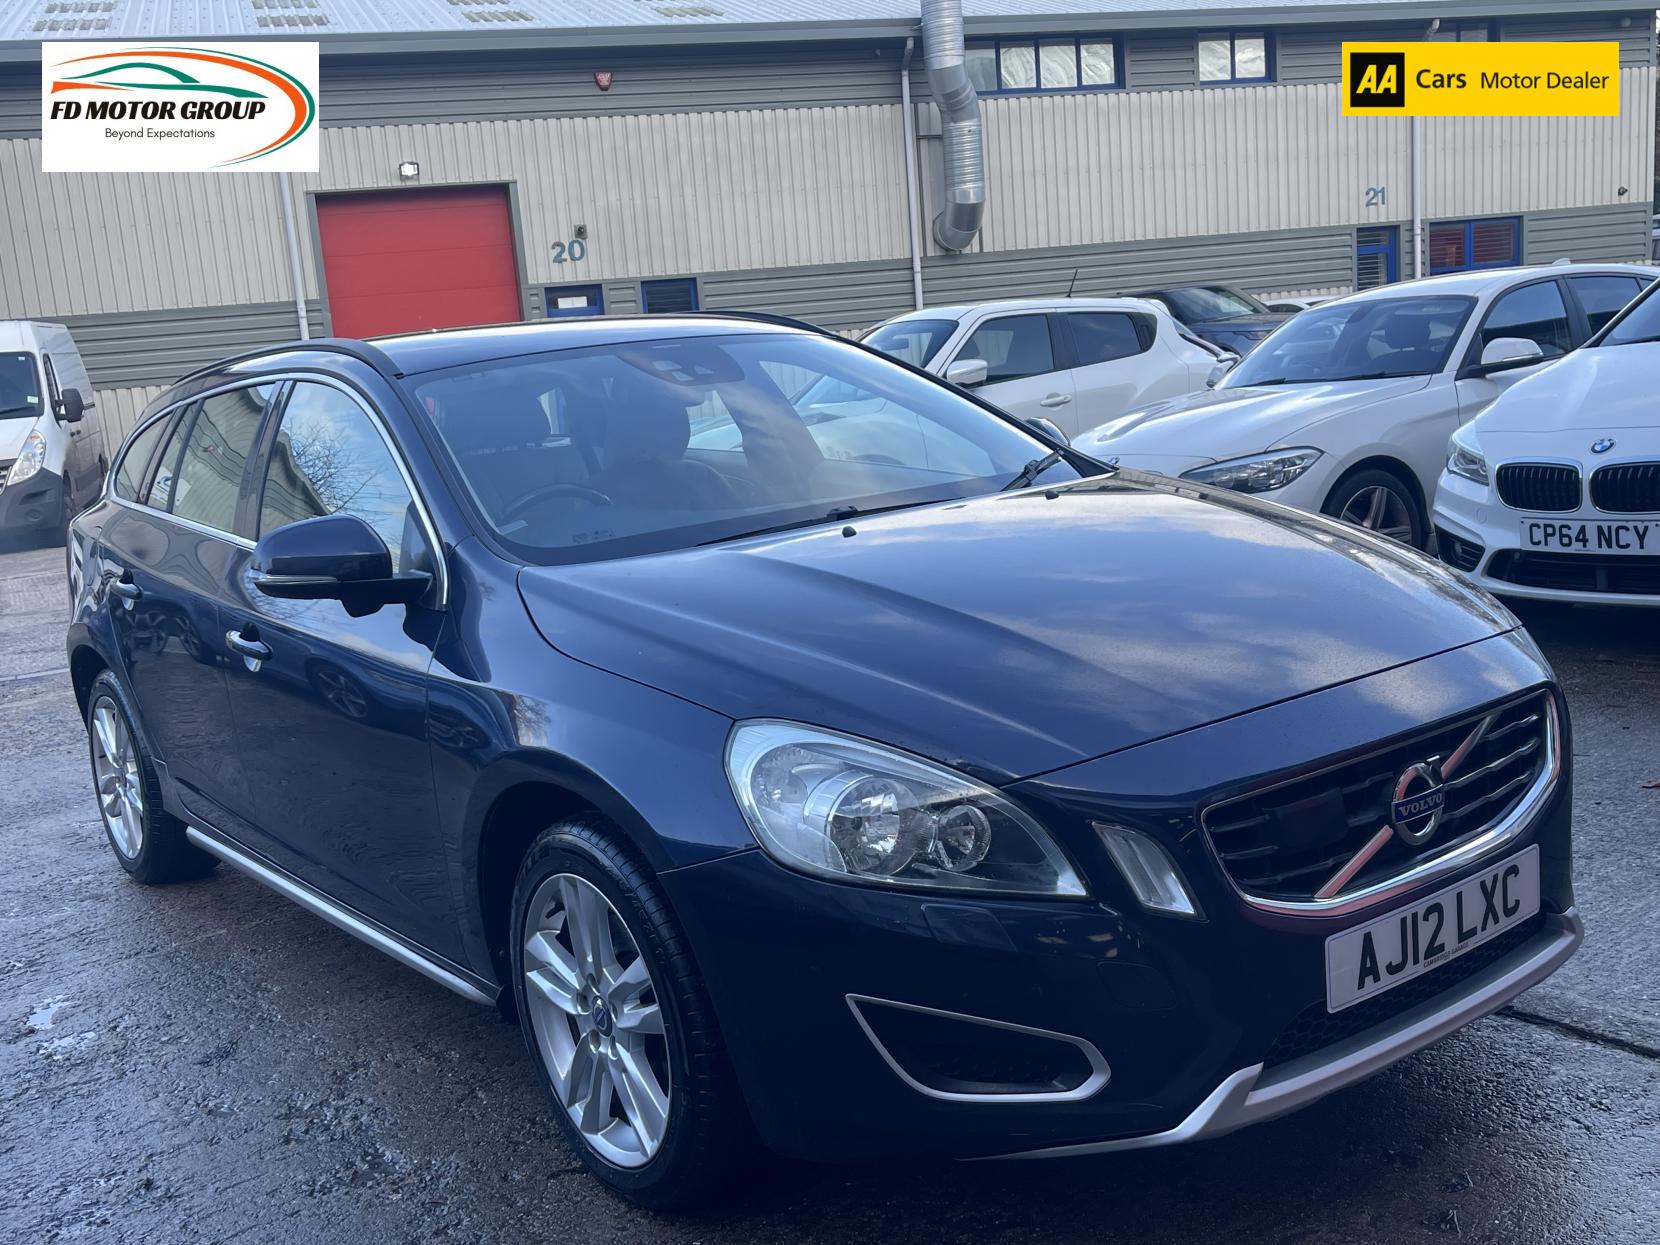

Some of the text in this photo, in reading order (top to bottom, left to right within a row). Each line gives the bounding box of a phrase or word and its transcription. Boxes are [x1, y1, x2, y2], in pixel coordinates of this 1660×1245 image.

[1365, 187, 1386, 208] 21
[551, 239, 586, 264] 20
[1529, 523, 1649, 550] CP64 NCY
[1398, 792, 1443, 817] VOLVO
[1357, 864, 1521, 990] AJ12 LXC
